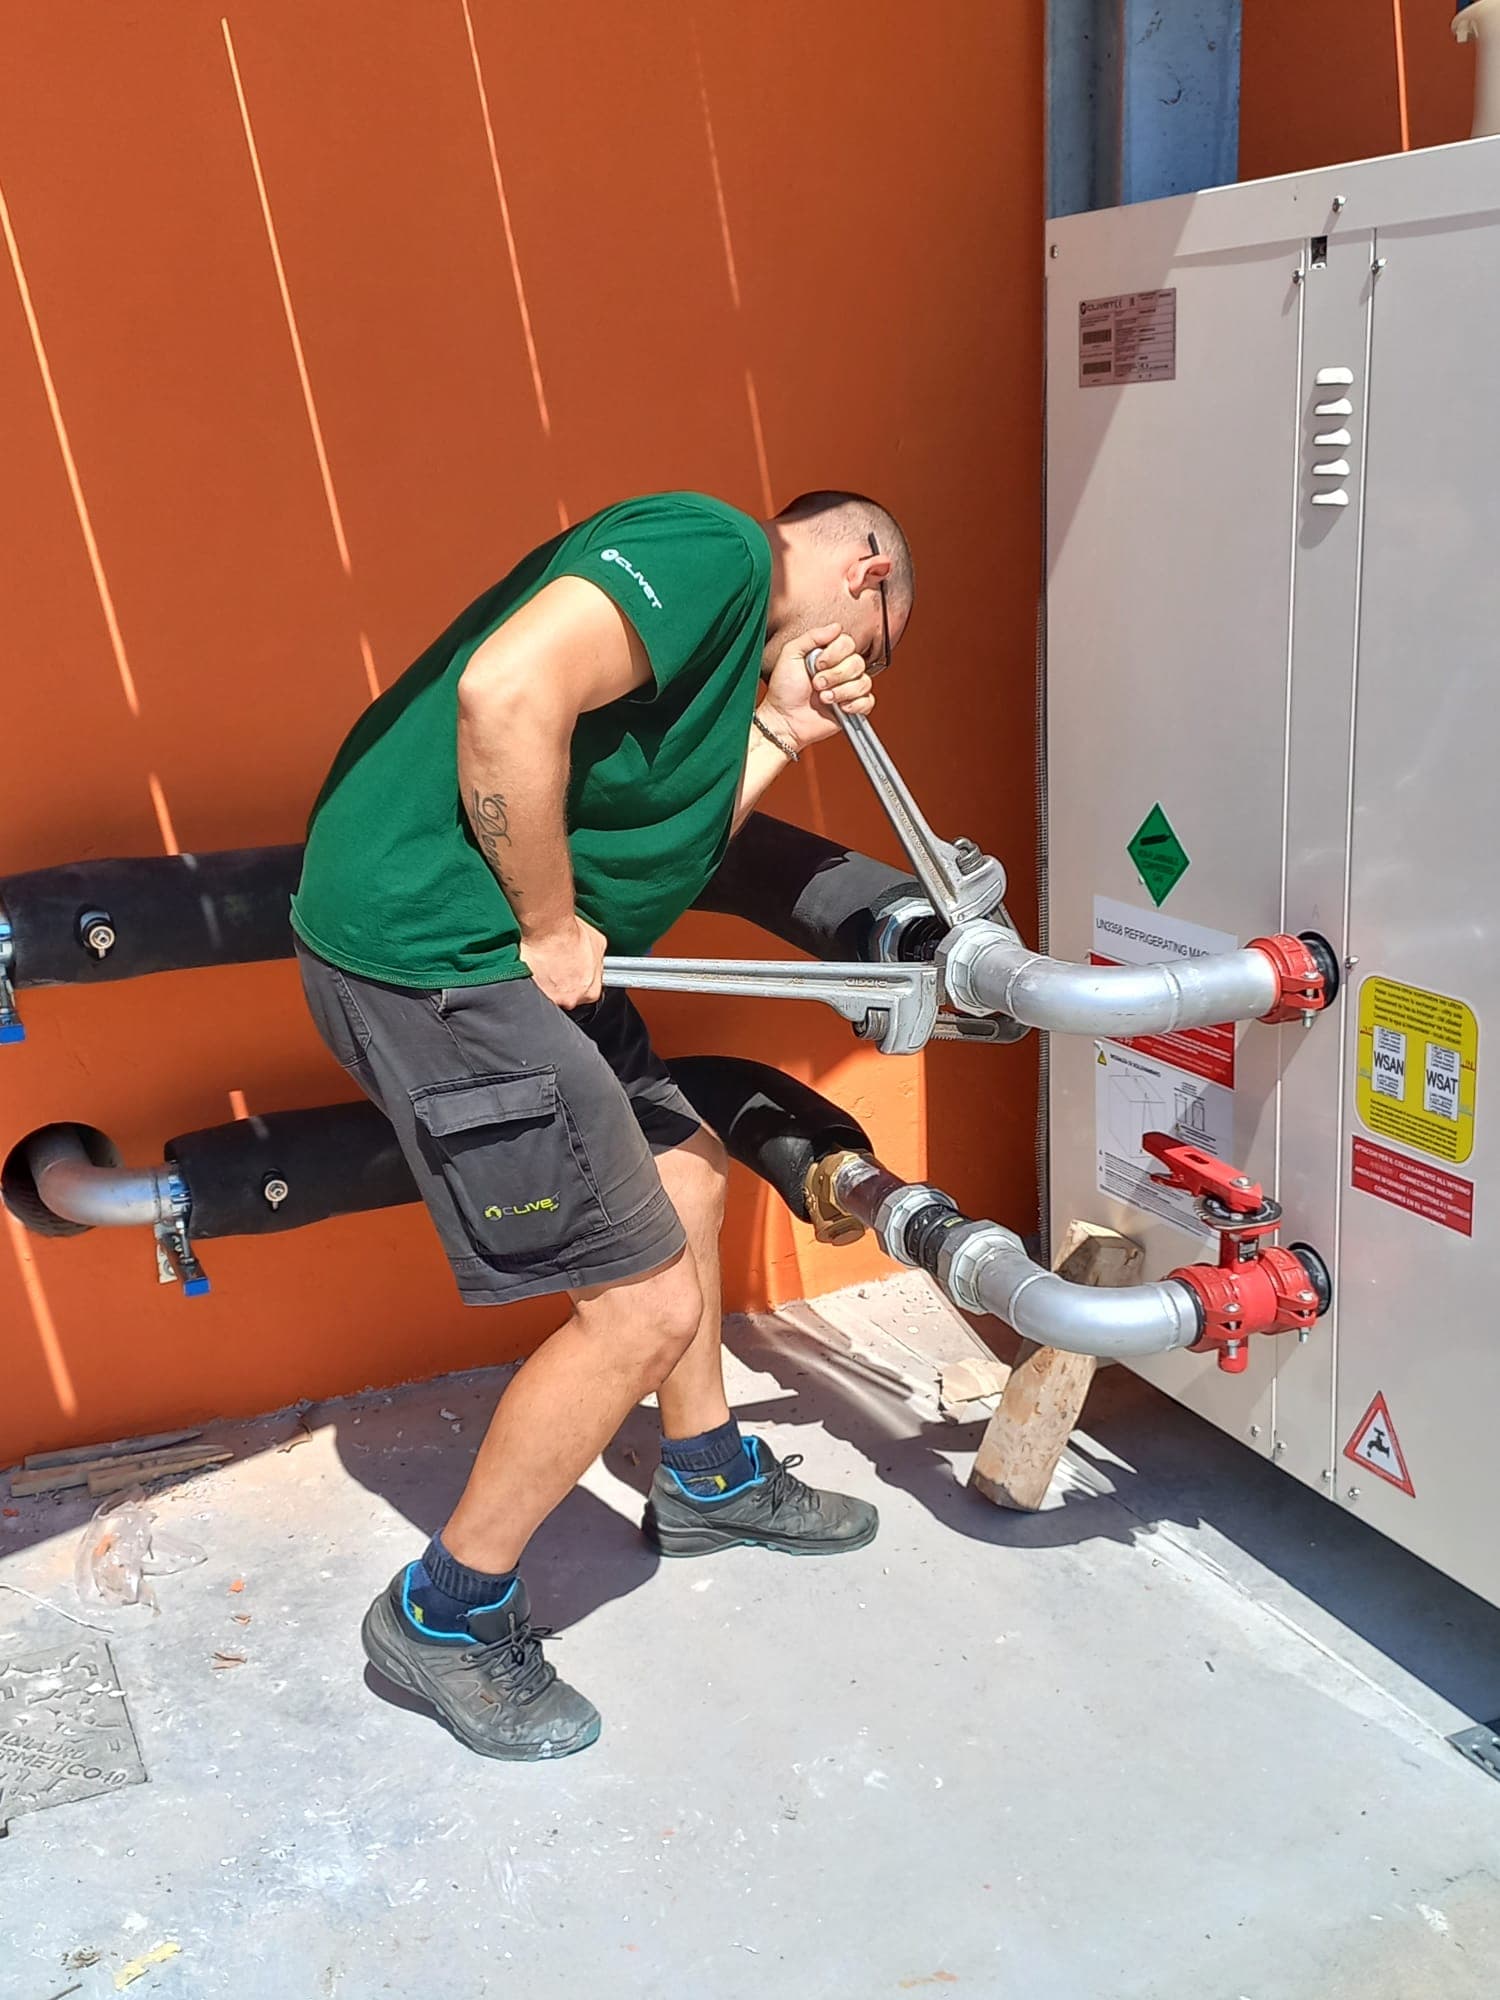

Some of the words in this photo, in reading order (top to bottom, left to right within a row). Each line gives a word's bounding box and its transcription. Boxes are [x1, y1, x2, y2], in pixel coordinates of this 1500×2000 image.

[615, 556, 662, 609] CLIVET
[1124, 927, 1187, 956] REFRIGERATING
[1373, 1050, 1404, 1076] WSAN
[1426, 1069, 1458, 1095] WSAT
